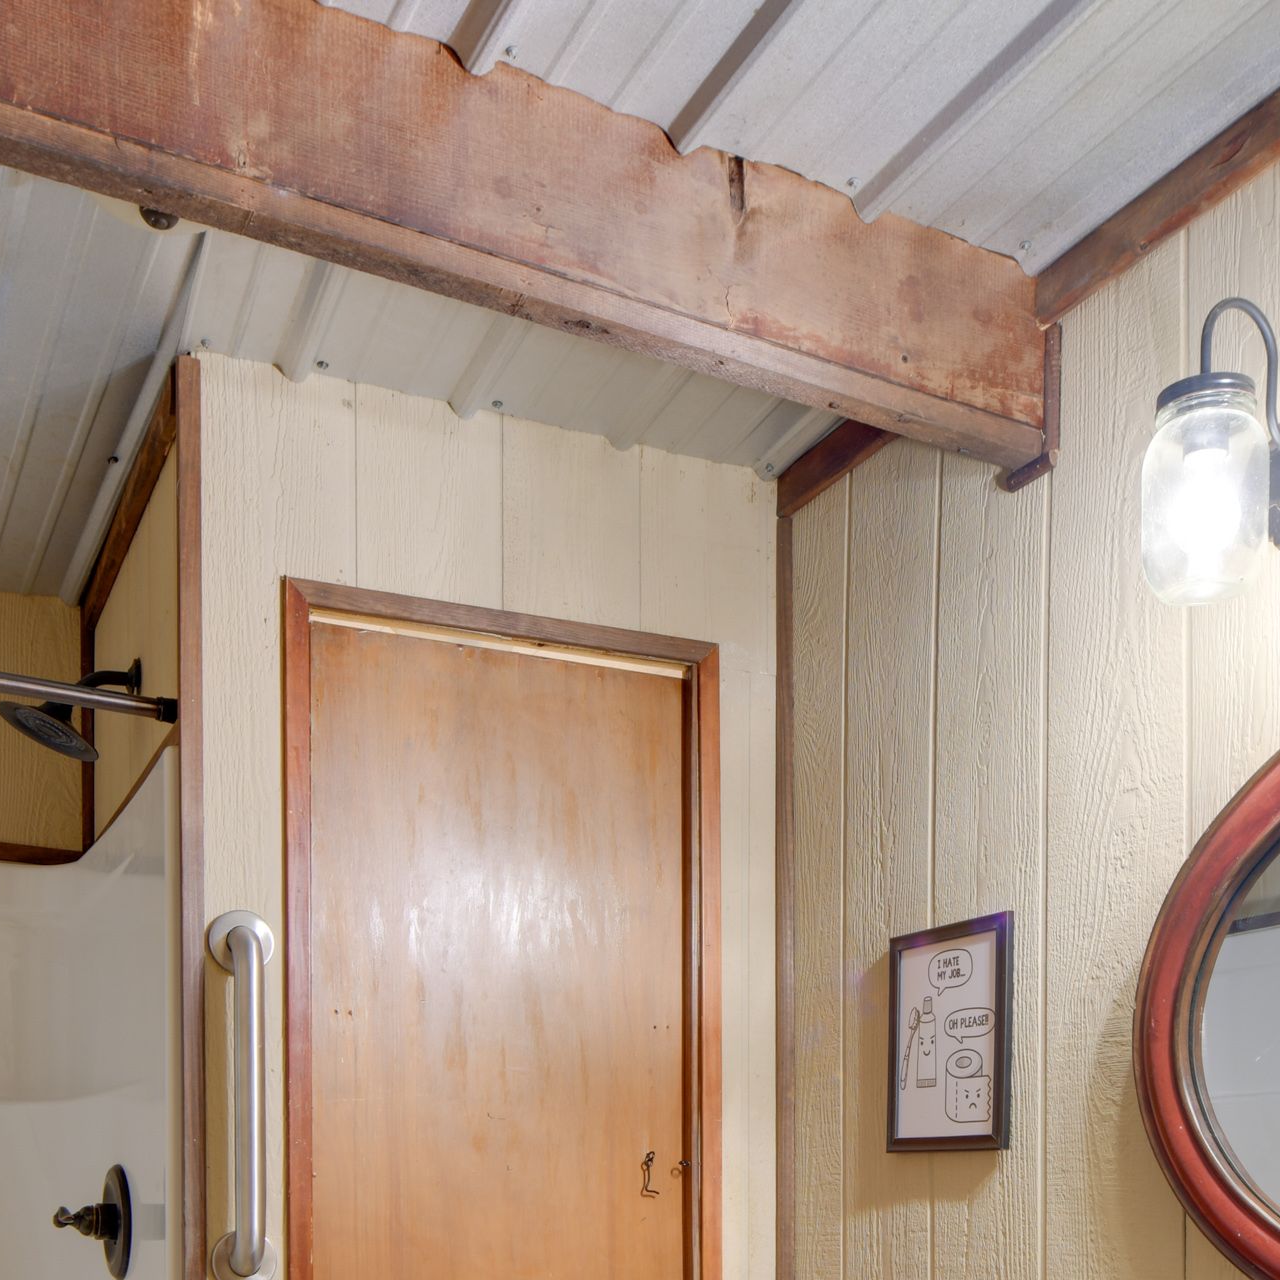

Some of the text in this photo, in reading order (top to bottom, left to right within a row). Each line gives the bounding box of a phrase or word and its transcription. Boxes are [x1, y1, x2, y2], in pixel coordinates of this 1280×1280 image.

[942, 955, 960, 968] HATE
[937, 971, 947, 981] MY
[948, 1018, 958, 1030] OH
